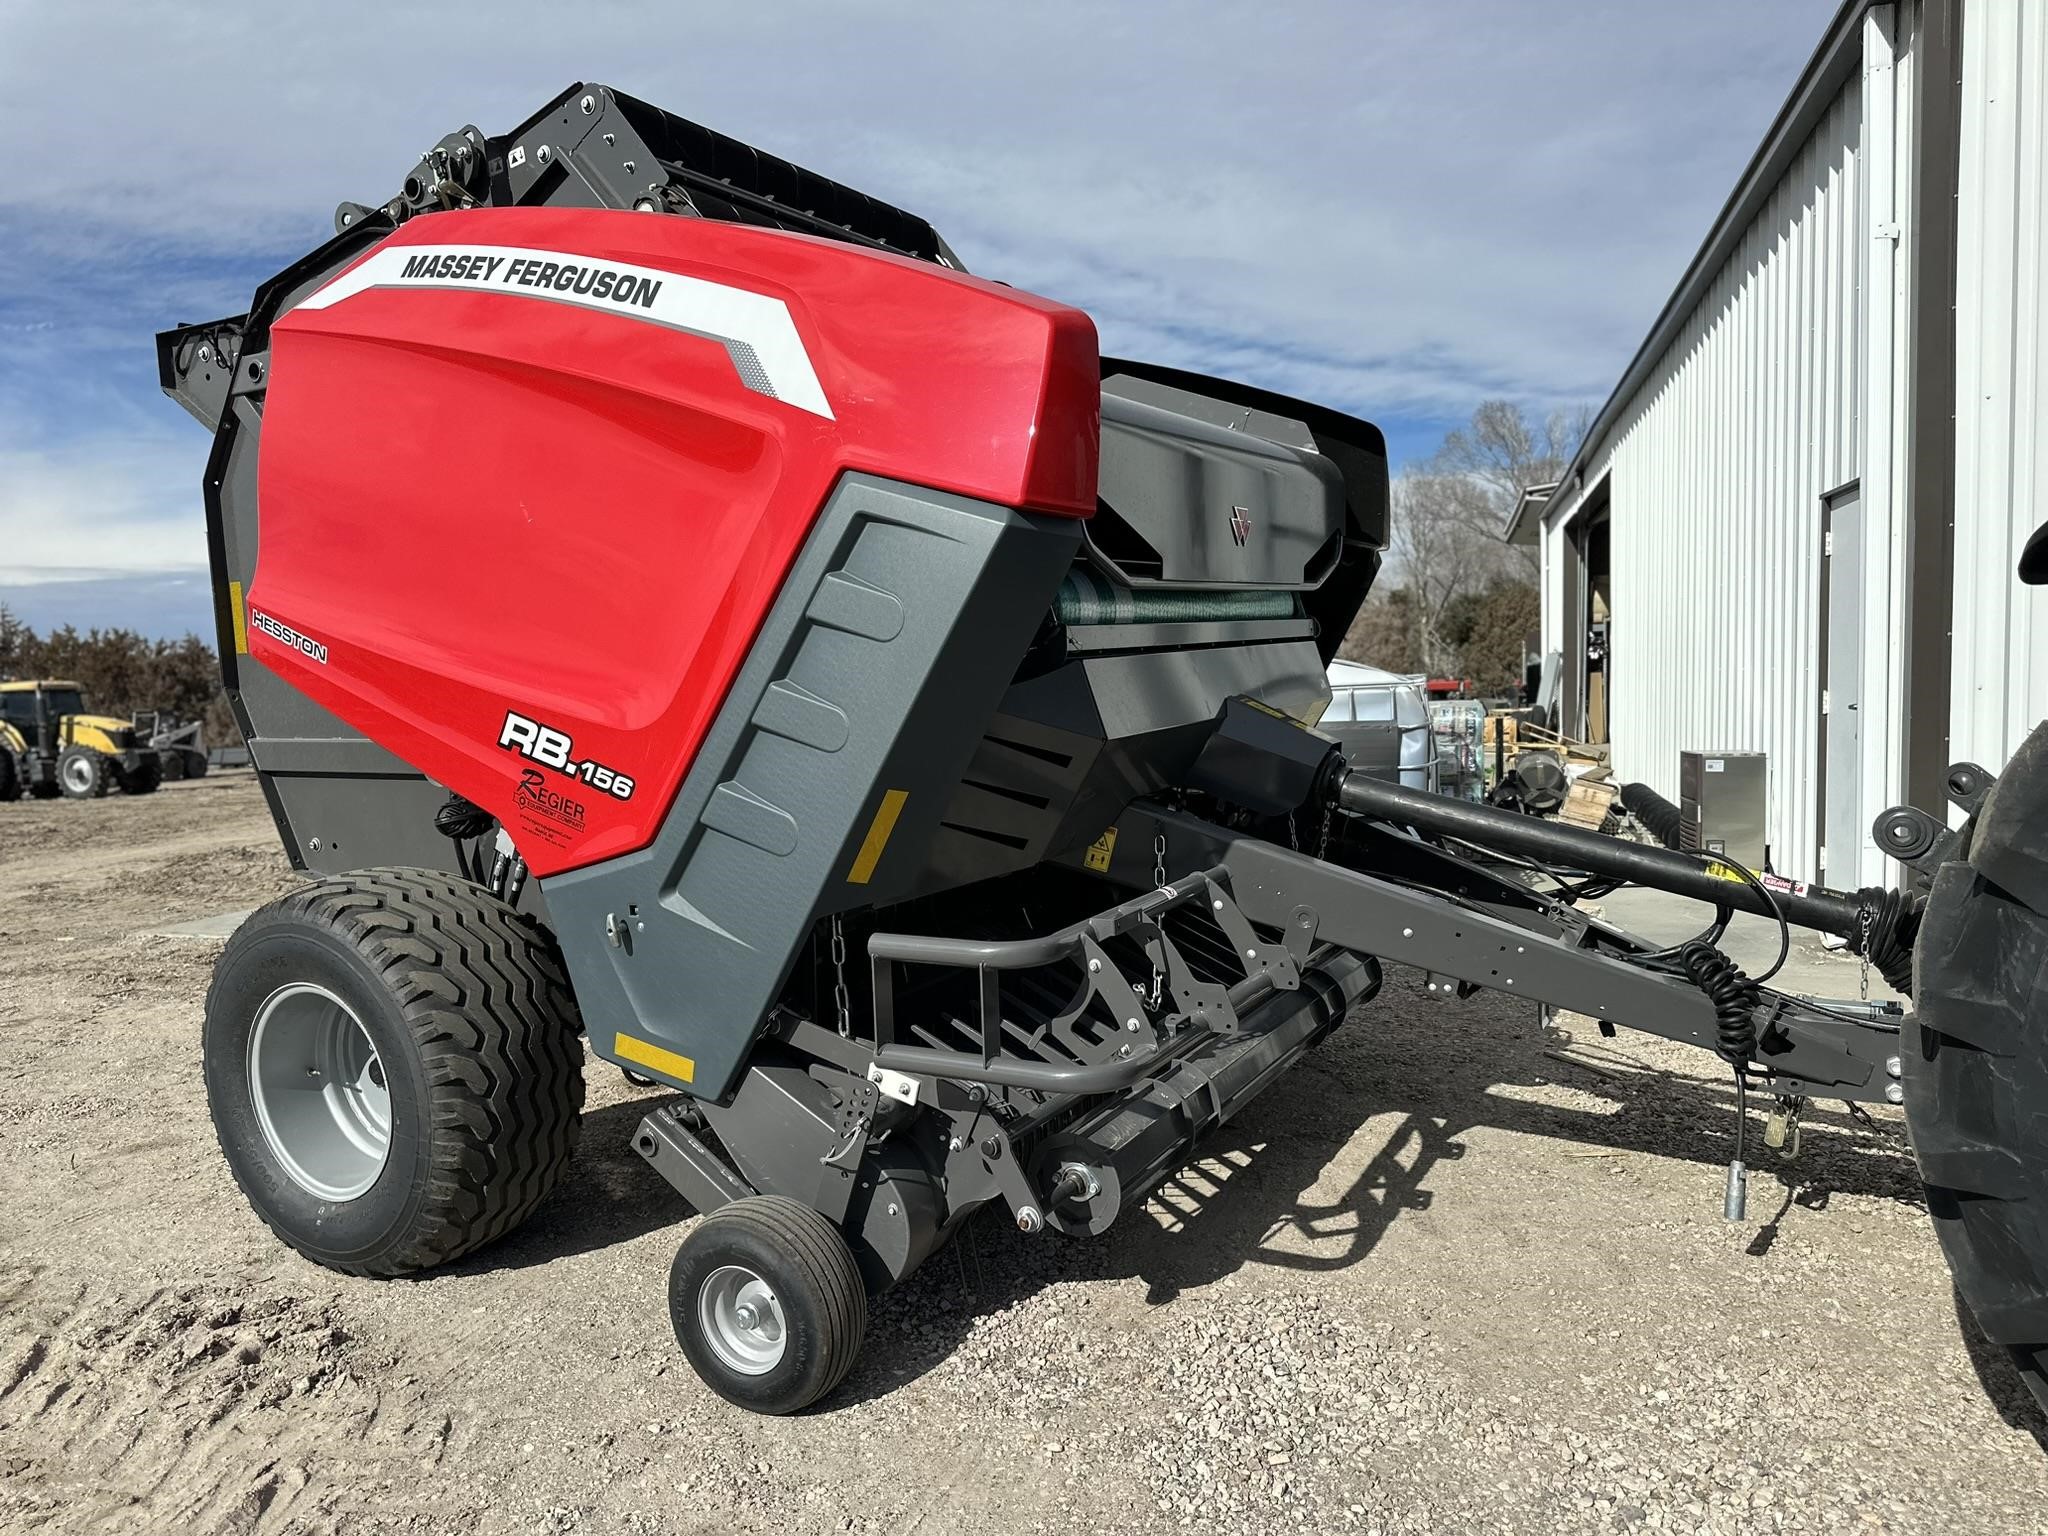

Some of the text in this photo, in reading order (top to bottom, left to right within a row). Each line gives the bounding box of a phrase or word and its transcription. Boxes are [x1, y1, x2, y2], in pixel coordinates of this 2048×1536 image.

[401, 255, 662, 308] MASSEY FERGUSON
[252, 609, 327, 664] HESSTON
[516, 768, 585, 822] REGIER
[527, 801, 557, 819] EQUIPMENT
[557, 814, 583, 830] COMPANY
